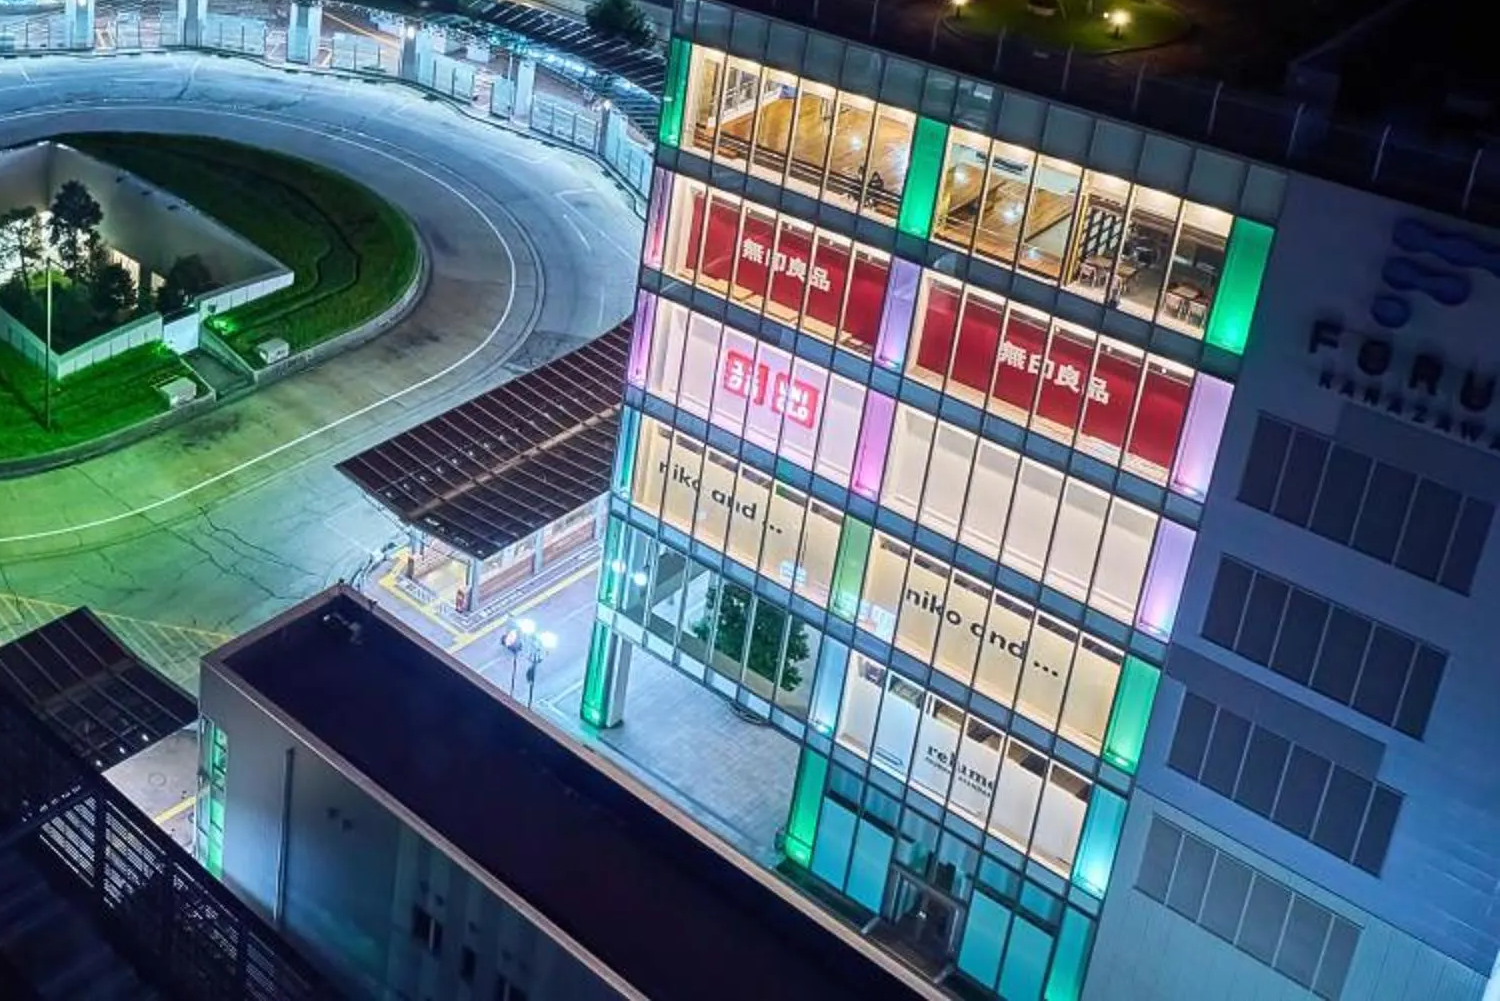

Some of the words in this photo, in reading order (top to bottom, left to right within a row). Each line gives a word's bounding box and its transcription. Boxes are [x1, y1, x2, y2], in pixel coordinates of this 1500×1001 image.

[742, 238, 831, 292] 無印良品
[997, 340, 1110, 405] 無印良品
[906, 588, 962, 626] niko
